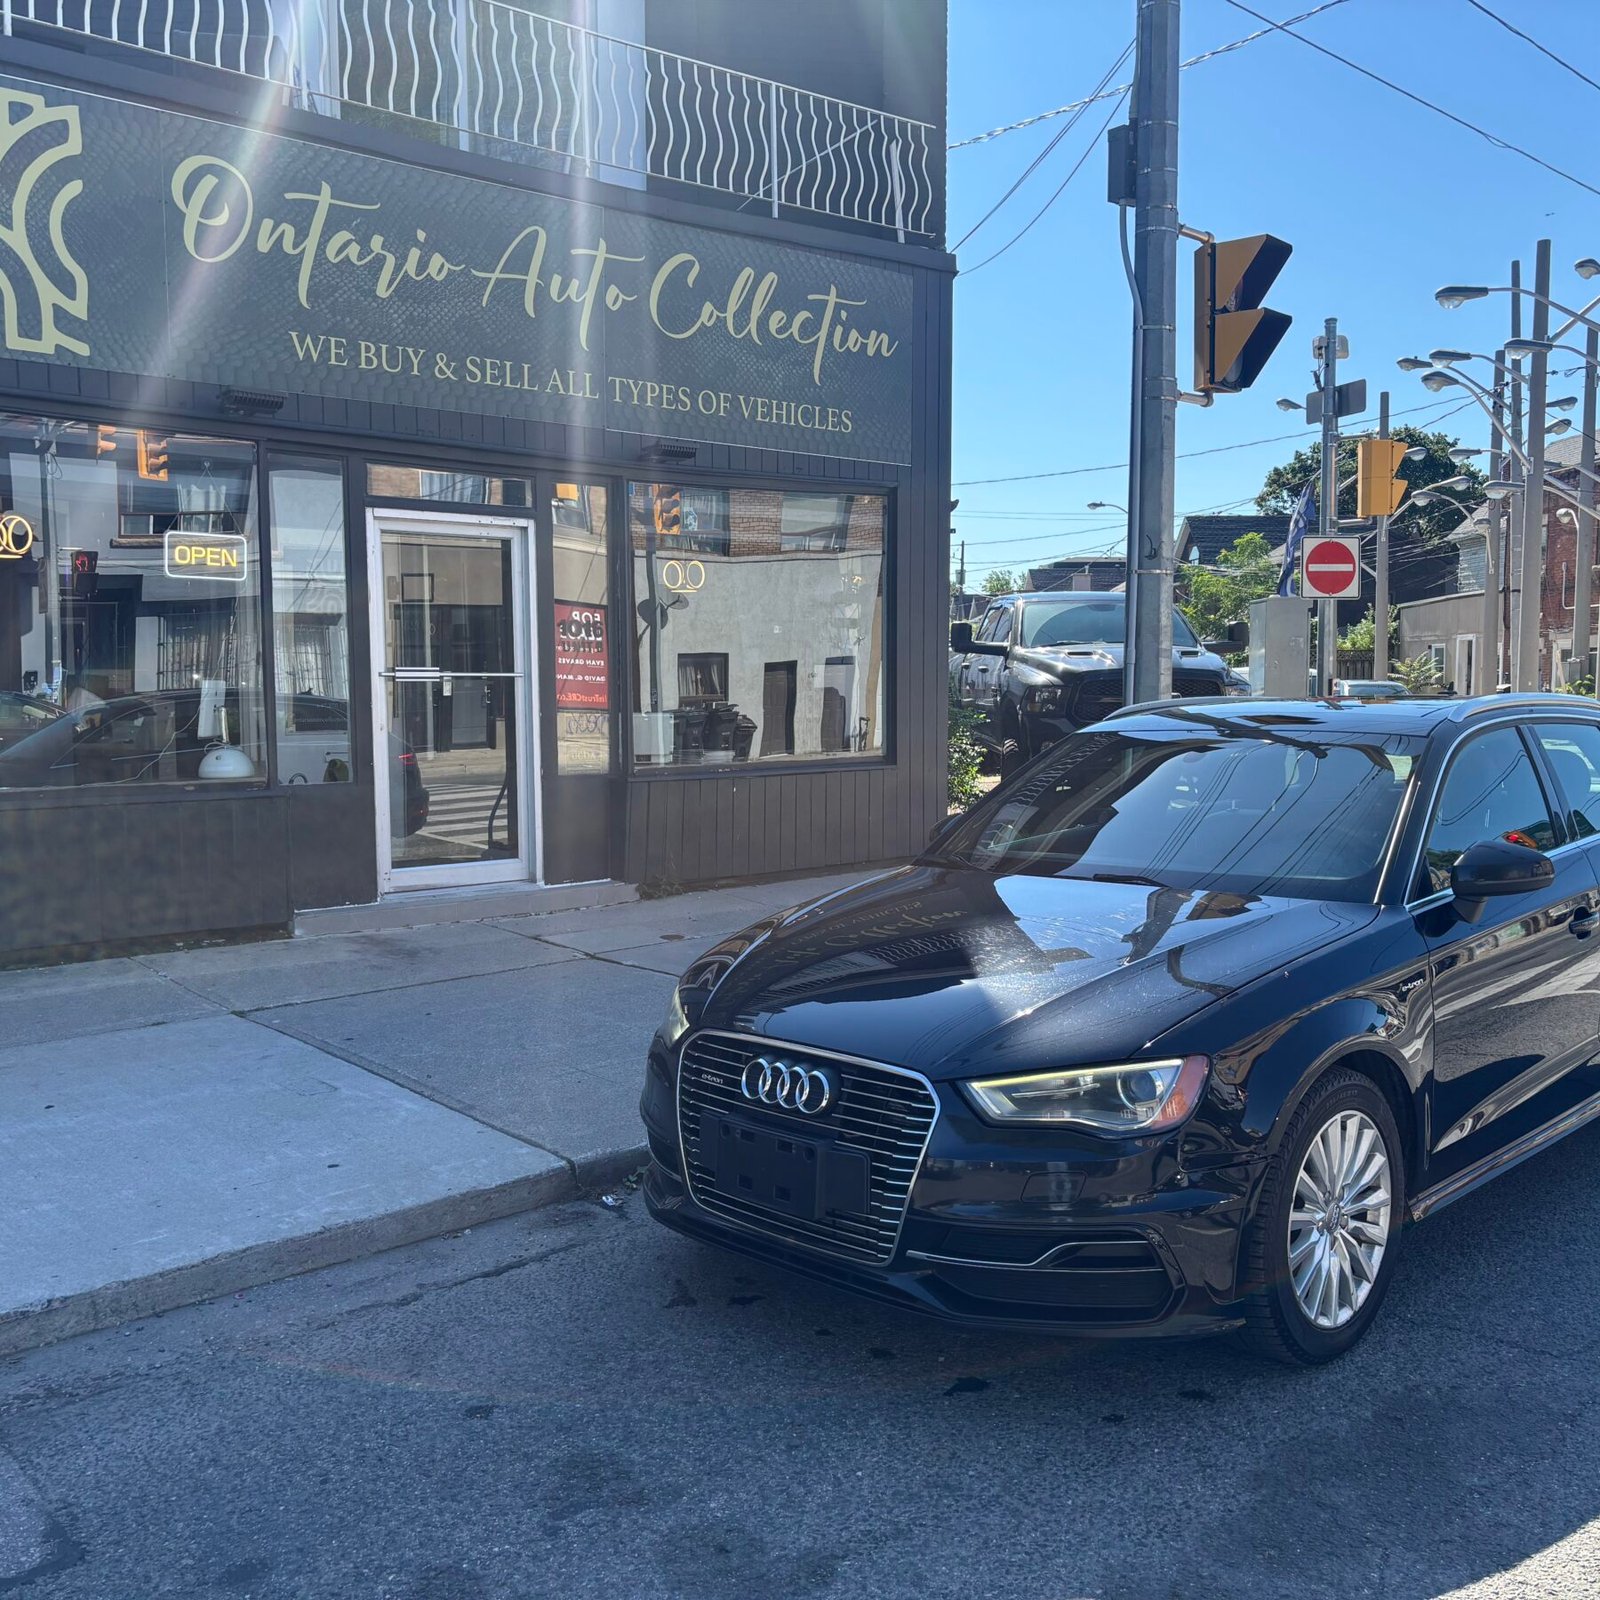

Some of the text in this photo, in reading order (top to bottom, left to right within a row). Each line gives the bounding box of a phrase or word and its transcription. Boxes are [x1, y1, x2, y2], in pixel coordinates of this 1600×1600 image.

[171, 155, 900, 386] Ontario Auto Collection
[288, 331, 853, 433] WE BUY & SELL ALL TYPES OF VEHICLES
[174, 545, 237, 567] OPEN
[1401, 978, 1424, 992] e-tron
[701, 1073, 724, 1085] e-tron
